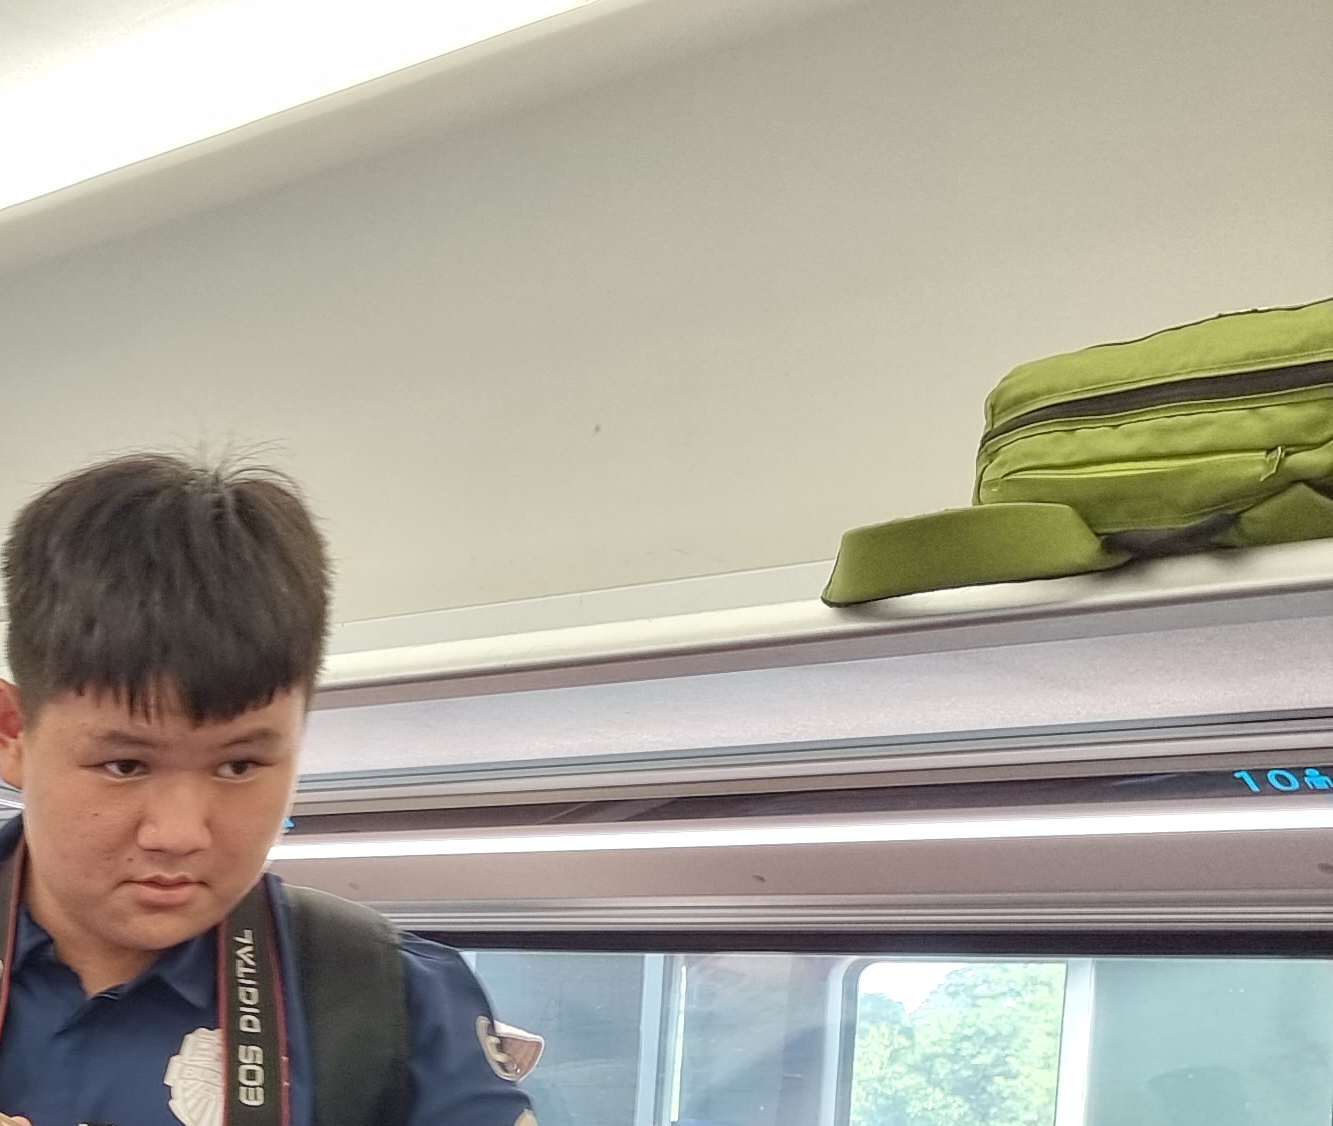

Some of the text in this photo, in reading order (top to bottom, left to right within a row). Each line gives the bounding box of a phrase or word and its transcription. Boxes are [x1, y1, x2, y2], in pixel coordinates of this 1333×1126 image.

[1233, 768, 1300, 792] 10
[234, 928, 265, 1107] EOS DIGITAL
